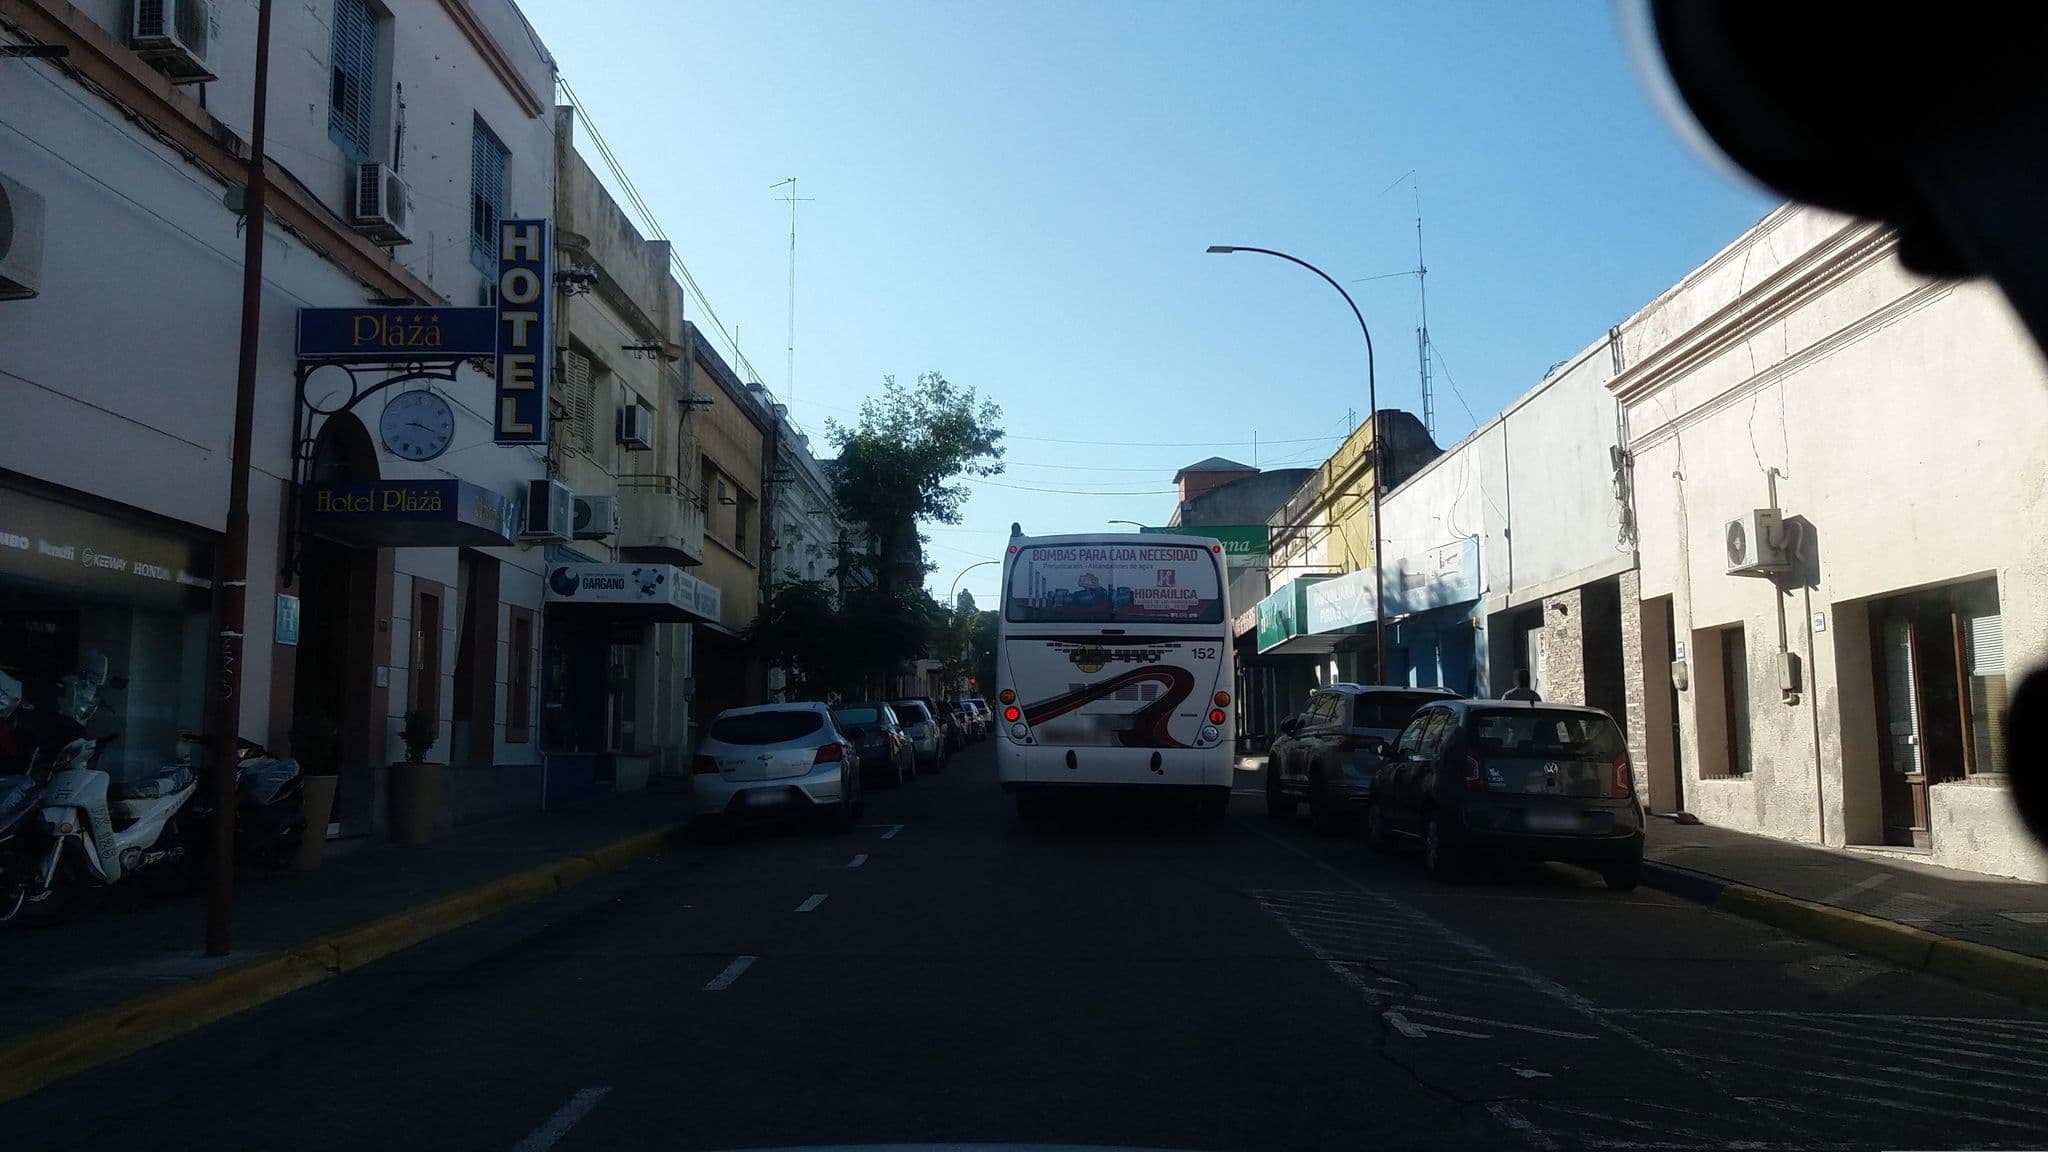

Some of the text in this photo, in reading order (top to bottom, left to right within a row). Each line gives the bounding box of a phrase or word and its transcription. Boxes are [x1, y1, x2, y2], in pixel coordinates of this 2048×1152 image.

[351, 313, 441, 347] Plaza
[500, 224, 541, 434] HOTEL
[316, 488, 443, 513] Hotel Plaza
[1032, 549, 1198, 562] BOMBAS PARA CADA NECESIDAD
[582, 577, 625, 590] GARGANO
[1191, 647, 1215, 660] 152
